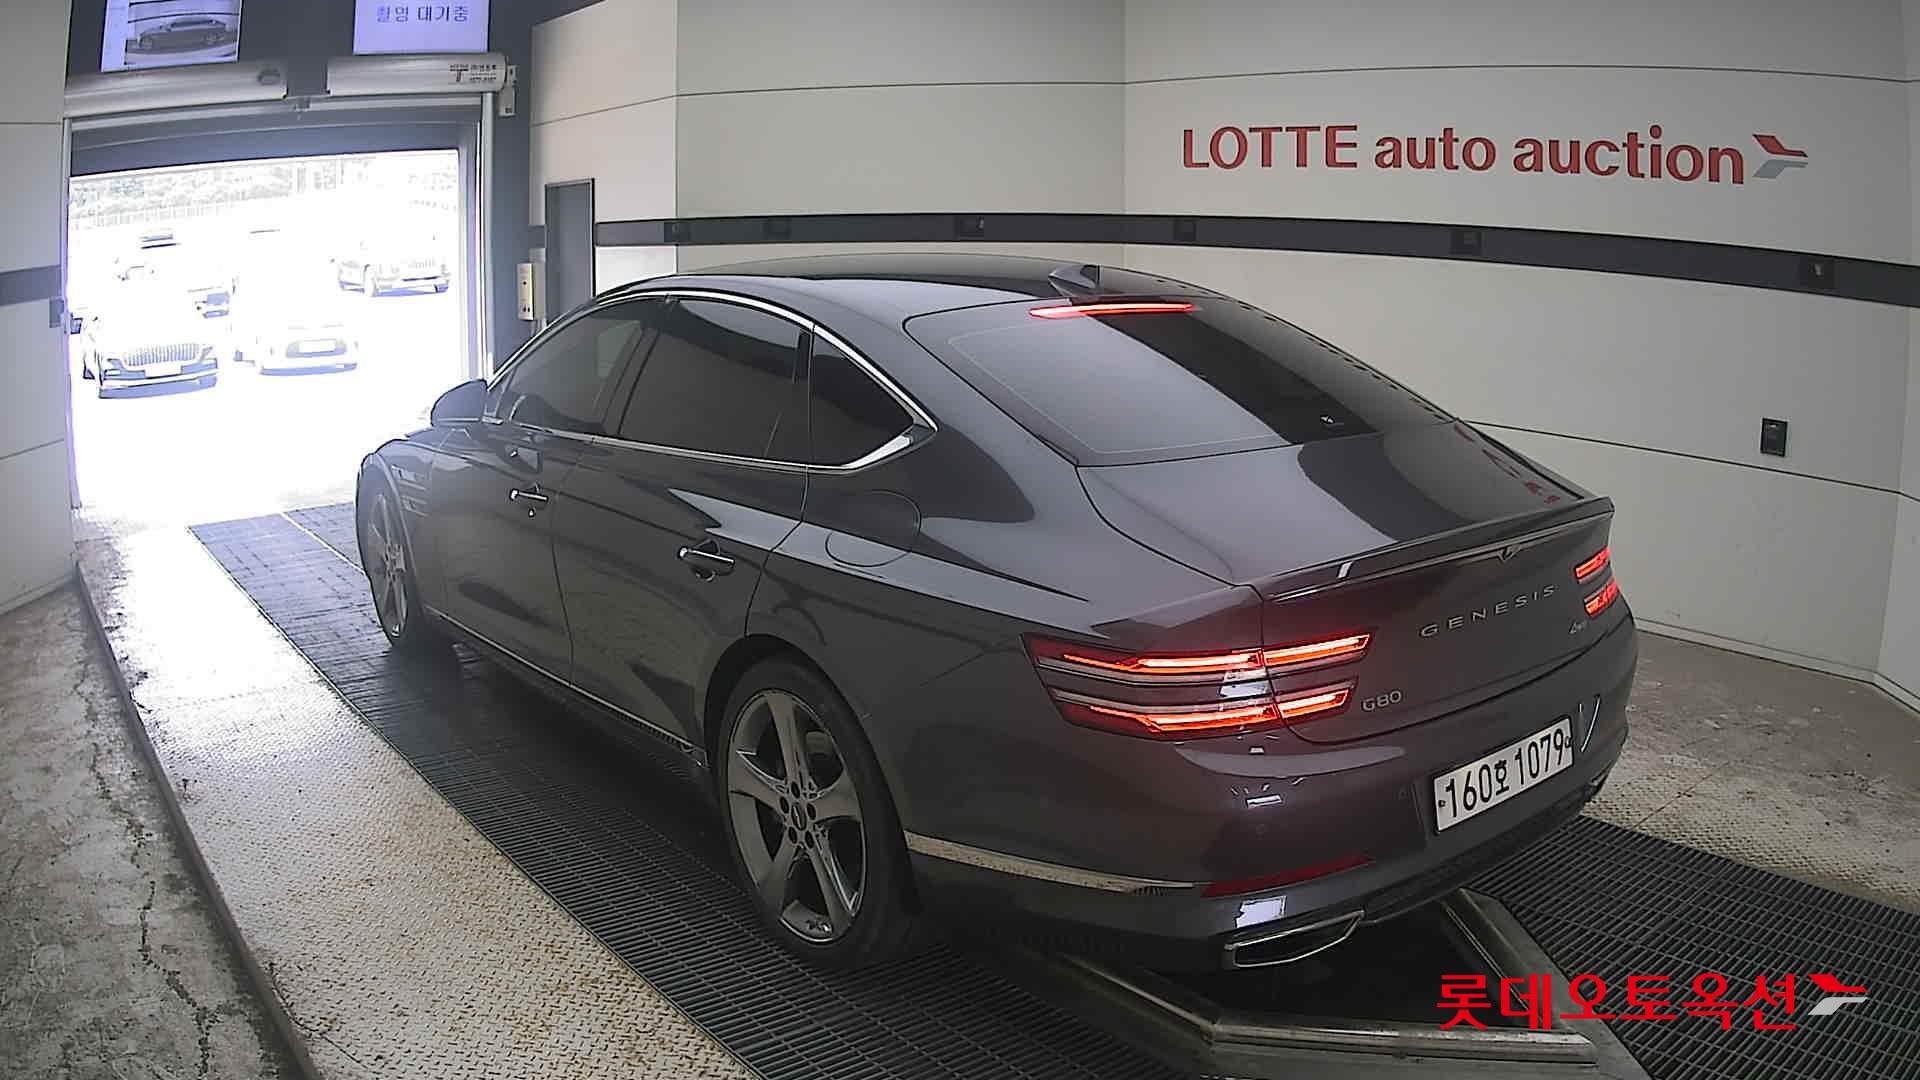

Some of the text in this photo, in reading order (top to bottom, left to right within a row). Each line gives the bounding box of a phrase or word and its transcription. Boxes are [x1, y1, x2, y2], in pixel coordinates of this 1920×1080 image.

[417, 6, 469, 22] 대기중
[1183, 125, 1745, 184] LOTTE auto auction
[1420, 585, 1555, 637] GENESIS
[1363, 690, 1402, 712] G80
[1445, 728, 1564, 818] 160호 1079
